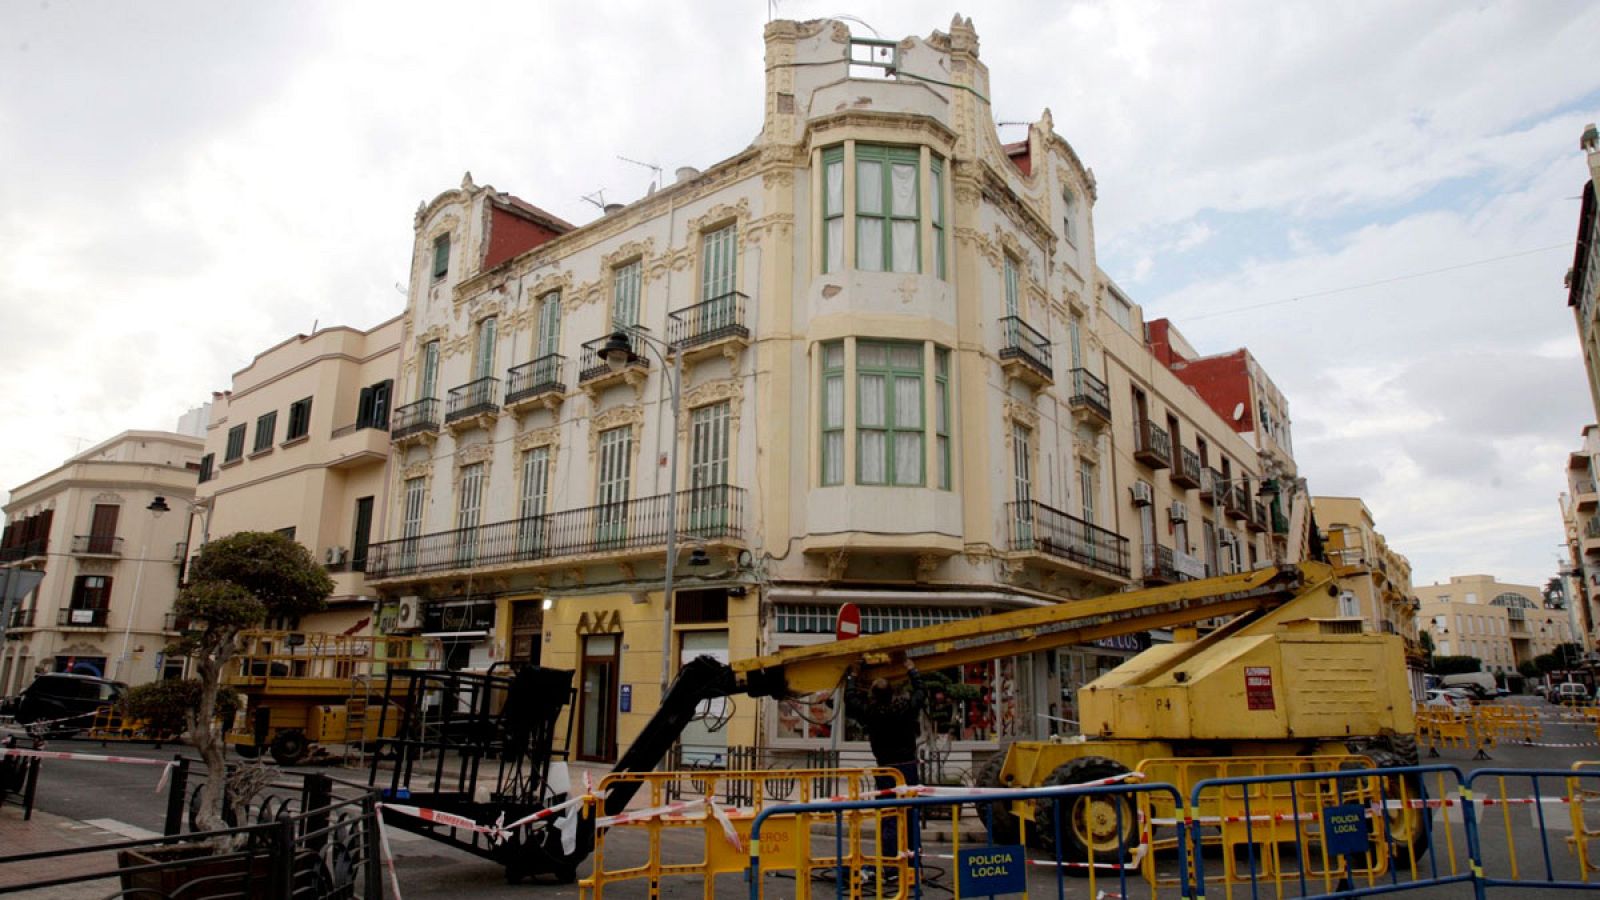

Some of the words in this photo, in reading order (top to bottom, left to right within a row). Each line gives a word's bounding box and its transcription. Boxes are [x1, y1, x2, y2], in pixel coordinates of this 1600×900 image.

[576, 609, 622, 635] AXA
[1331, 814, 1360, 824] POLICIA
[1334, 824, 1358, 834] LOCAL
[968, 853, 1012, 866] POLICIA
[971, 865, 1009, 878] LOCAL
